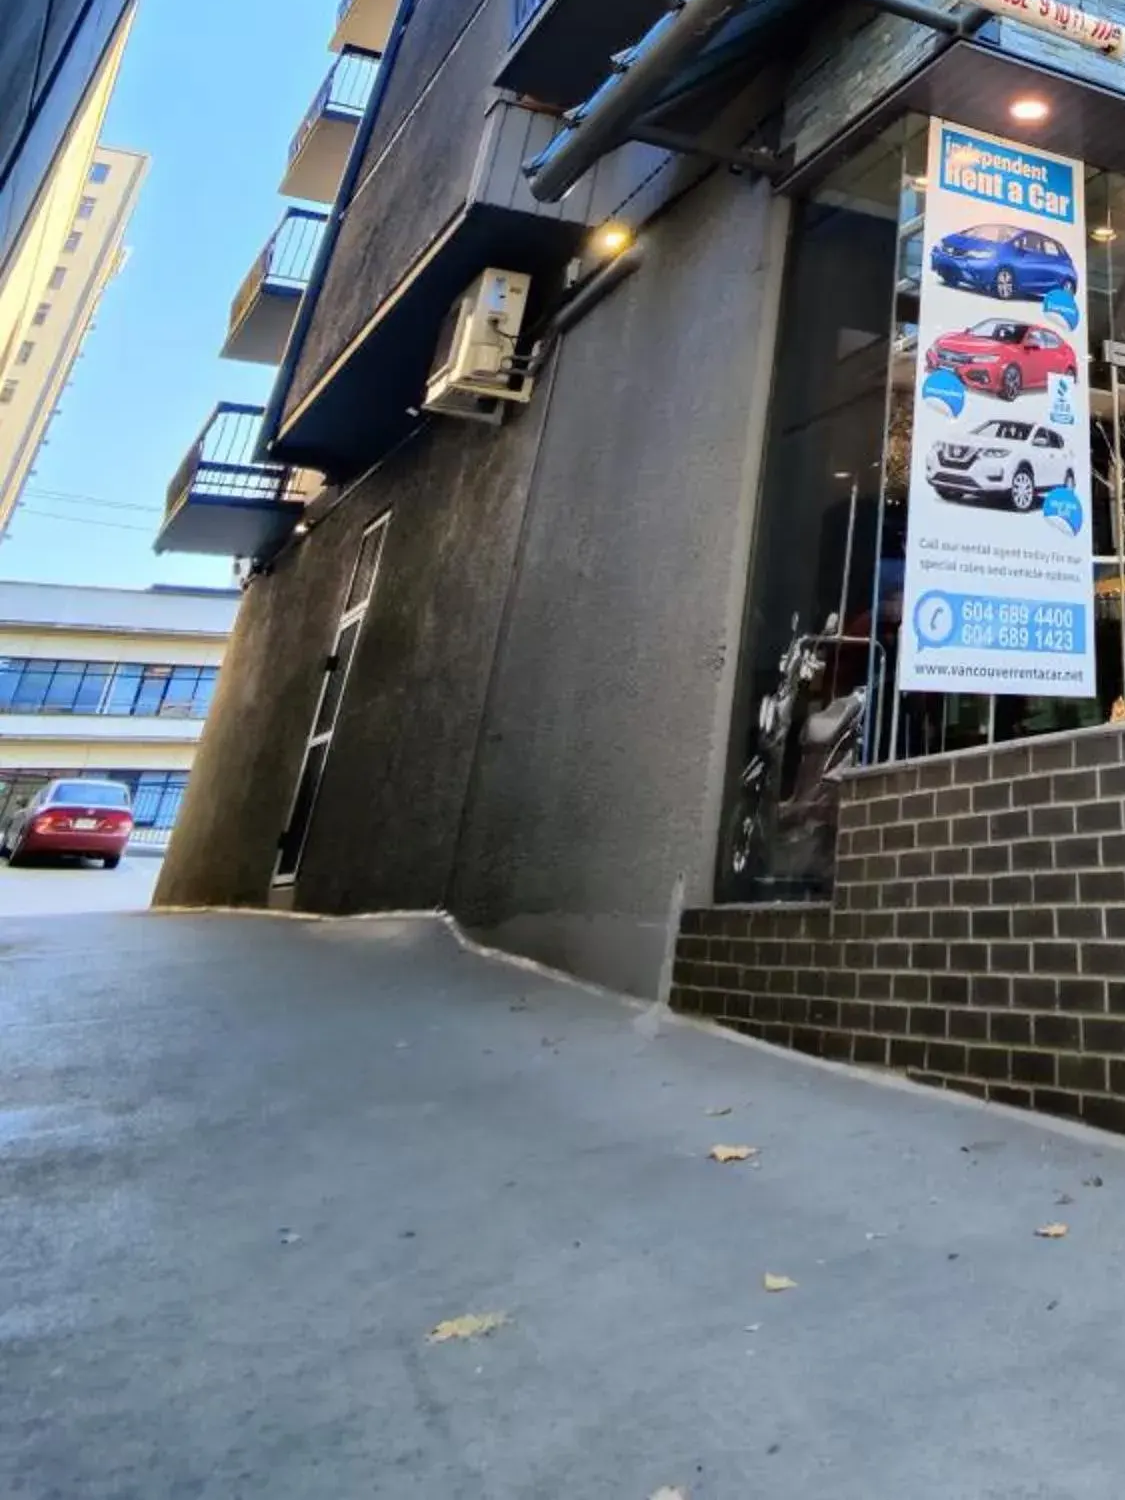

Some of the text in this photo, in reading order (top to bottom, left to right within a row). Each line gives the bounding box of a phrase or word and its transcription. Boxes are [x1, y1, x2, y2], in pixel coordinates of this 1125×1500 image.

[946, 135, 1048, 182] Inpendent
[945, 161, 1070, 216] Rent a Car
[962, 600, 1073, 628] 604 689 4400
[961, 623, 1073, 651] 604 689 1423
